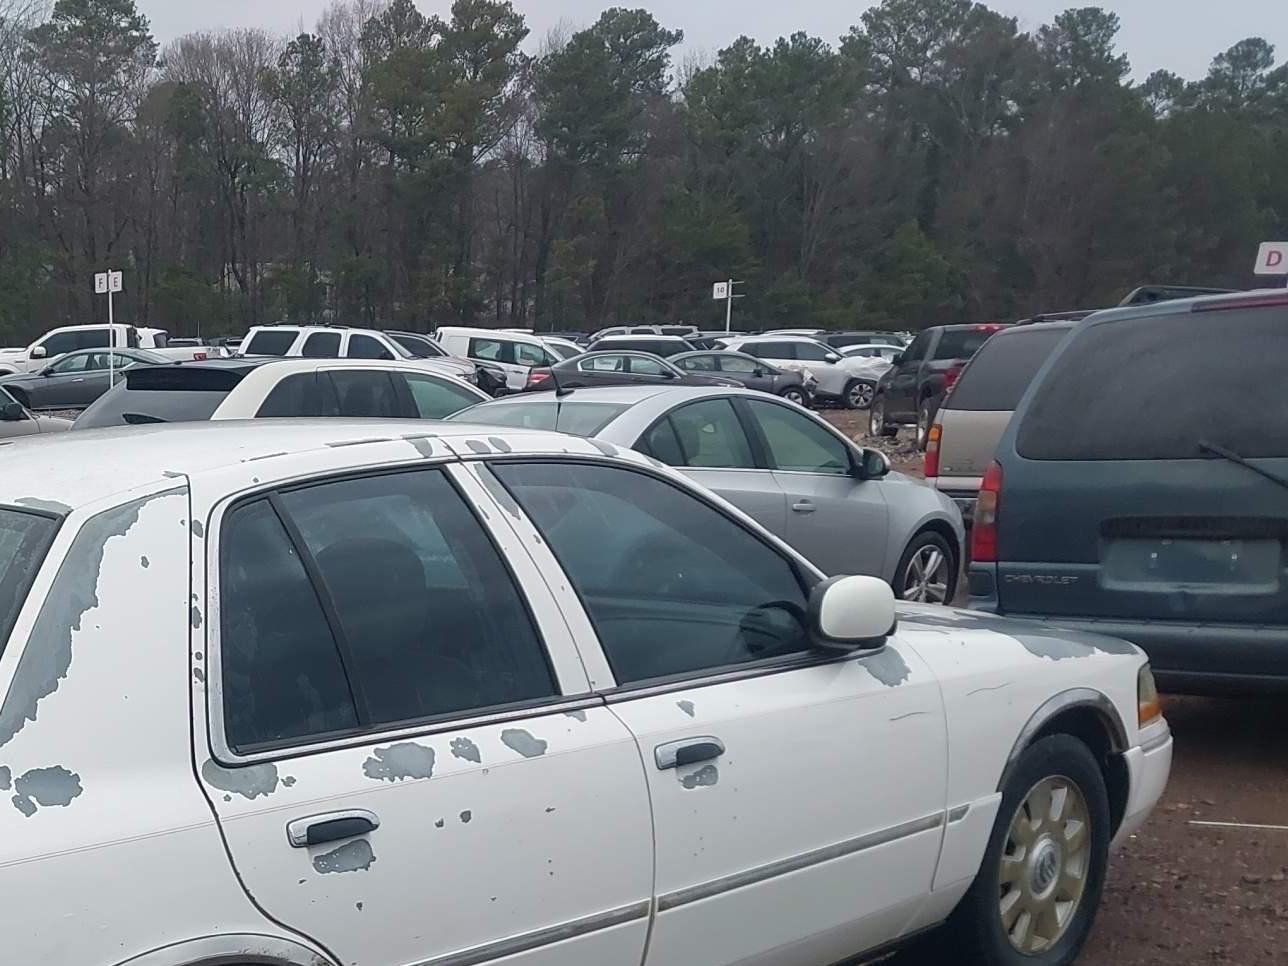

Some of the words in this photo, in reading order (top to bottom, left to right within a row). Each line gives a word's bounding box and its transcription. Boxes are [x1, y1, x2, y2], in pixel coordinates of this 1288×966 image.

[1265, 250, 1283, 266] D
[98, 277, 104, 289] F
[113, 276, 119, 288] E
[1004, 574, 1080, 584] CHEVROLET
